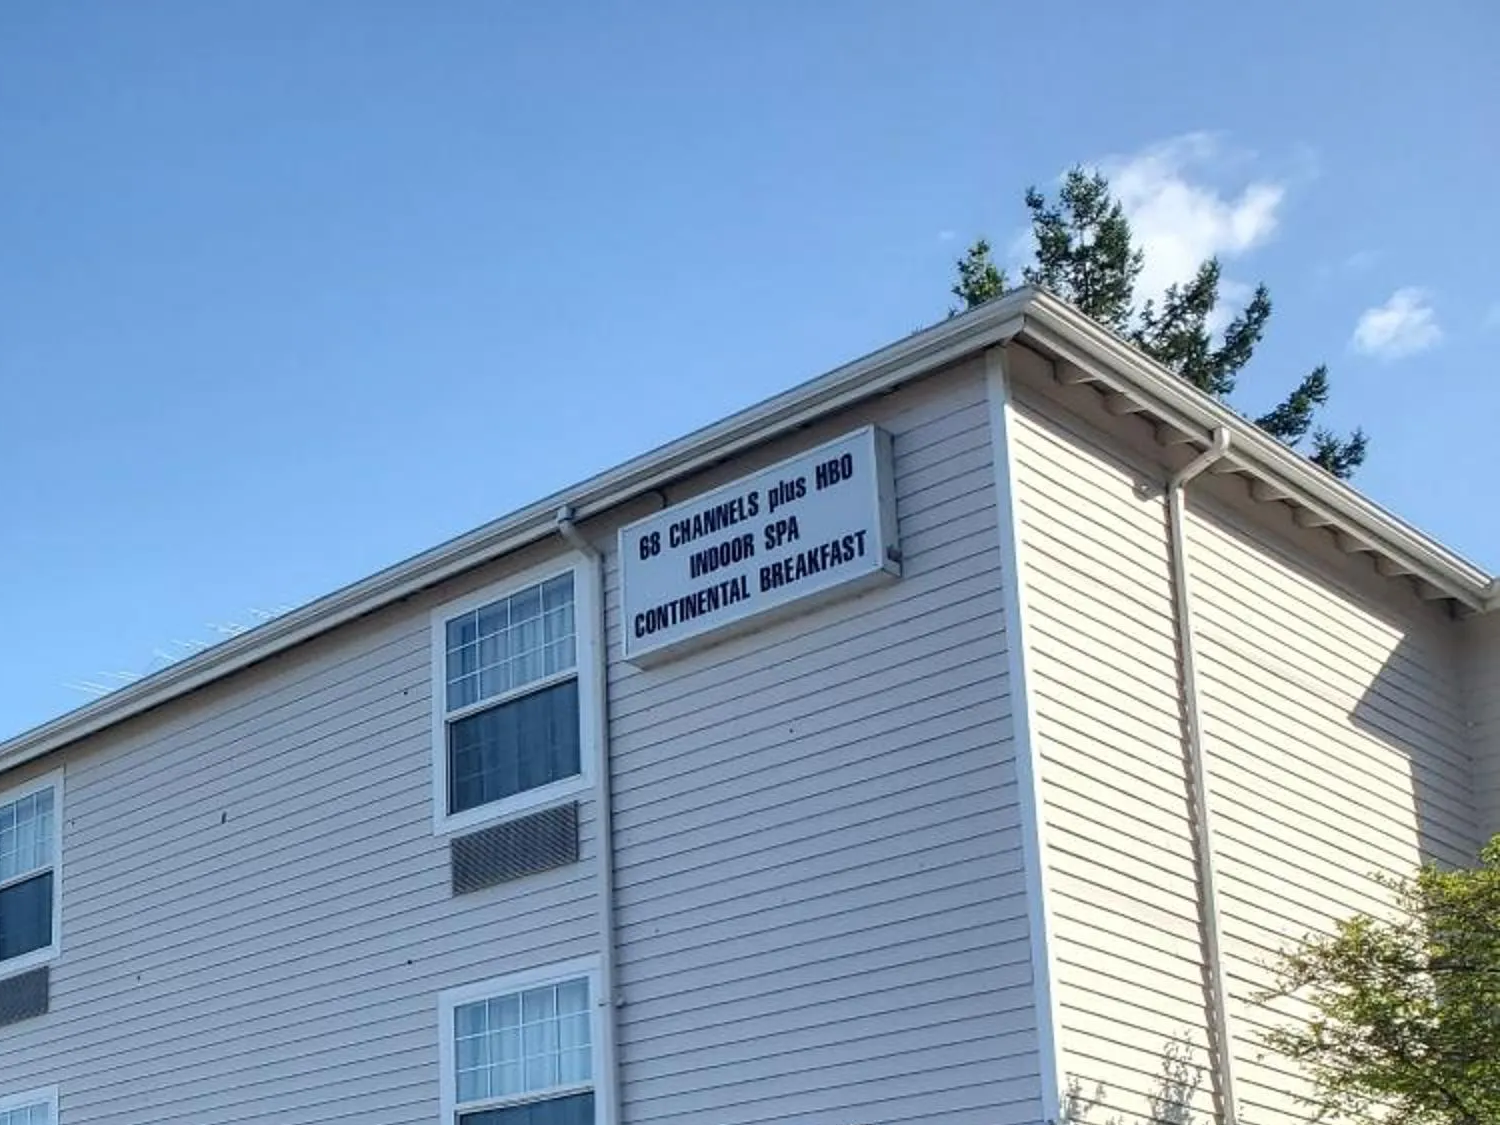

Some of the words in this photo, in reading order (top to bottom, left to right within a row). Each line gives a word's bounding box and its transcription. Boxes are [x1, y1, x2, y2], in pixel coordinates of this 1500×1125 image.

[639, 531, 660, 560] 68
[669, 491, 759, 548] CHANNELS
[768, 477, 806, 513] plus
[815, 453, 853, 490] HBO
[689, 533, 755, 579] INDOOR
[764, 516, 799, 550] SPA
[634, 575, 750, 638] CONTINENTAL
[759, 530, 867, 592] BREAKFAST
